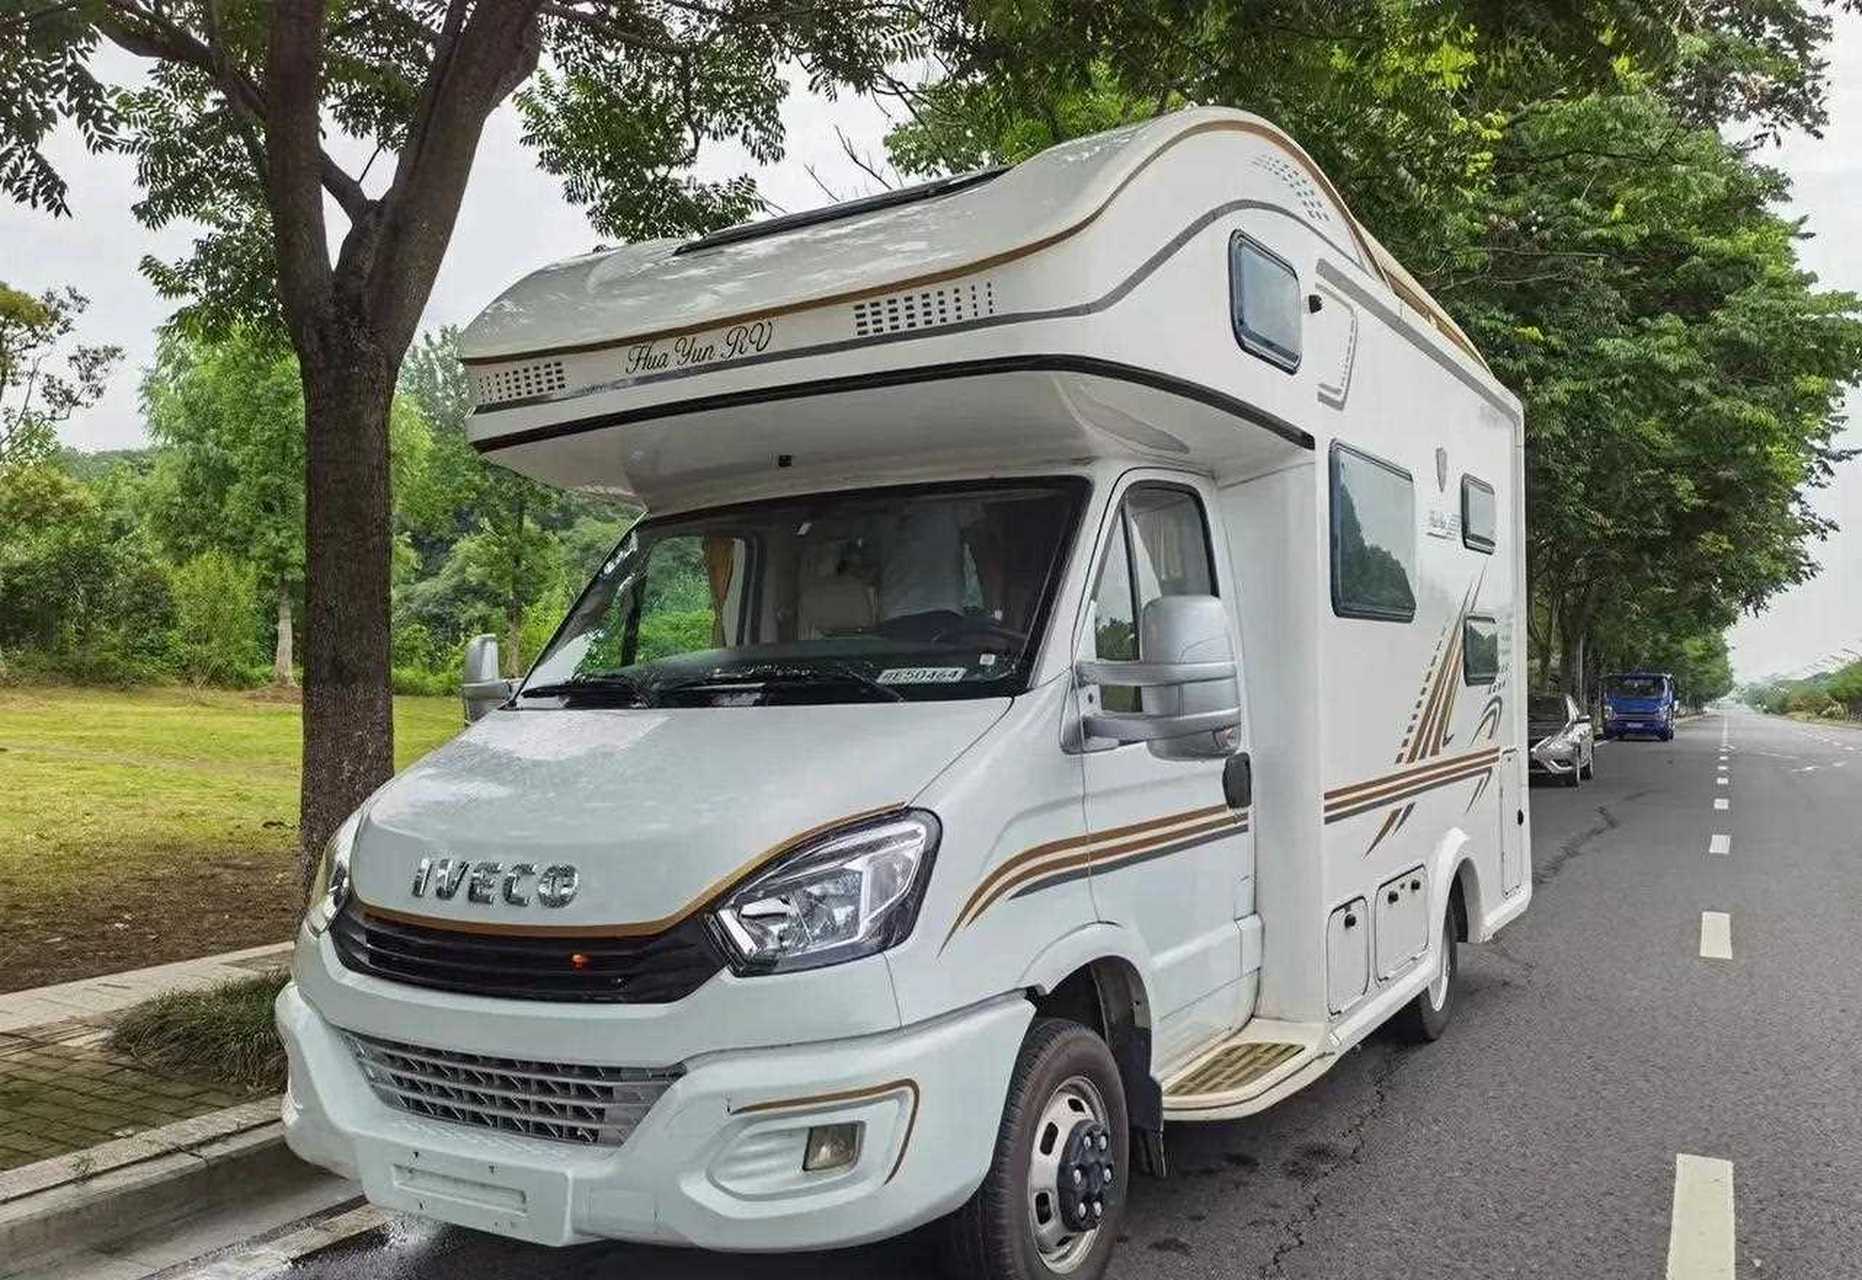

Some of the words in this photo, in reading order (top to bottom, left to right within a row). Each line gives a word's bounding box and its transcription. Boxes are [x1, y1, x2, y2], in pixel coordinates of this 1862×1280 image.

[625, 341, 669, 374] Hua
[674, 336, 716, 365] Yun
[720, 321, 773, 358] RV
[412, 858, 579, 909] IVECO
